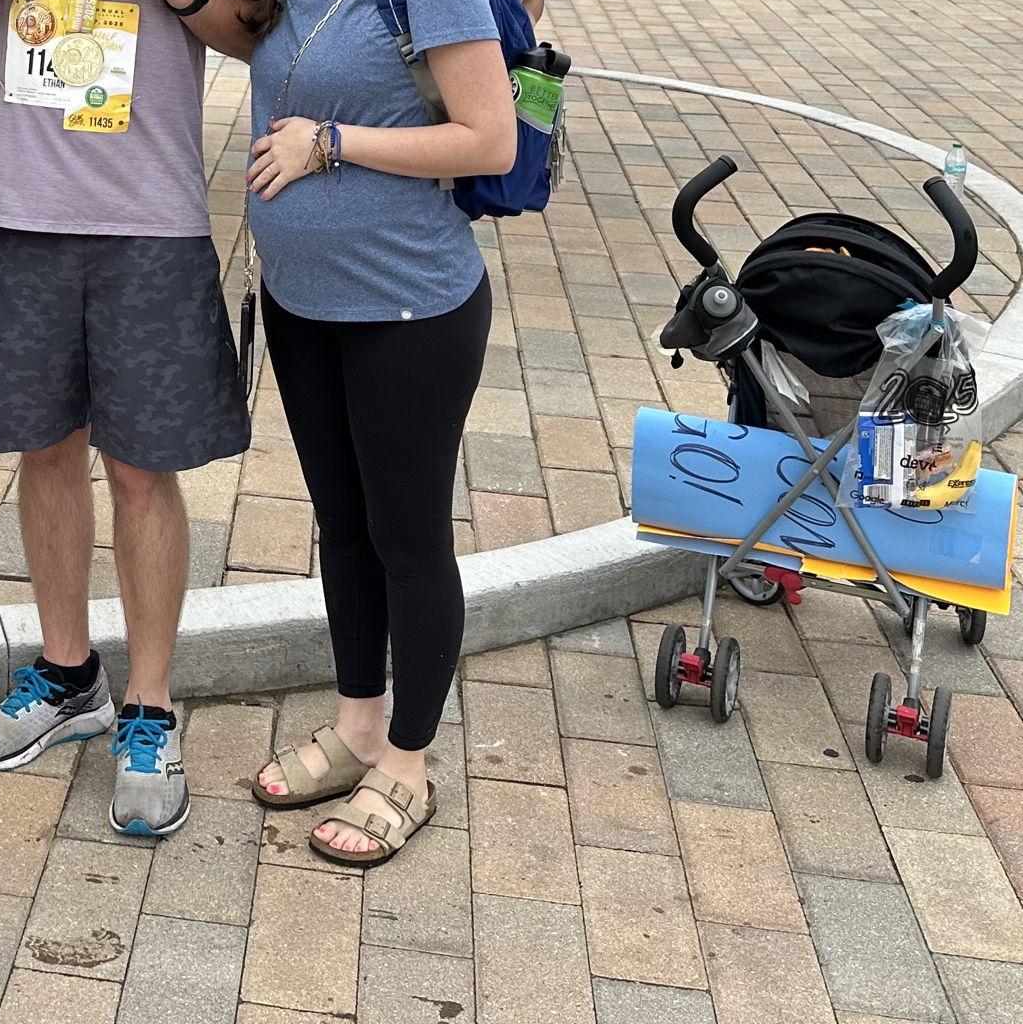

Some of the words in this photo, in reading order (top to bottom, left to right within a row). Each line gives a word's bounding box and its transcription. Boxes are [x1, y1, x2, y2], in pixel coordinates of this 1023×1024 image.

[84, 0, 96, 20] 2025
[26, 48, 58, 78] 114
[43, 78, 66, 89] ETHAN
[89, 116, 113, 128] 11435
[849, 489, 886, 505] Google
